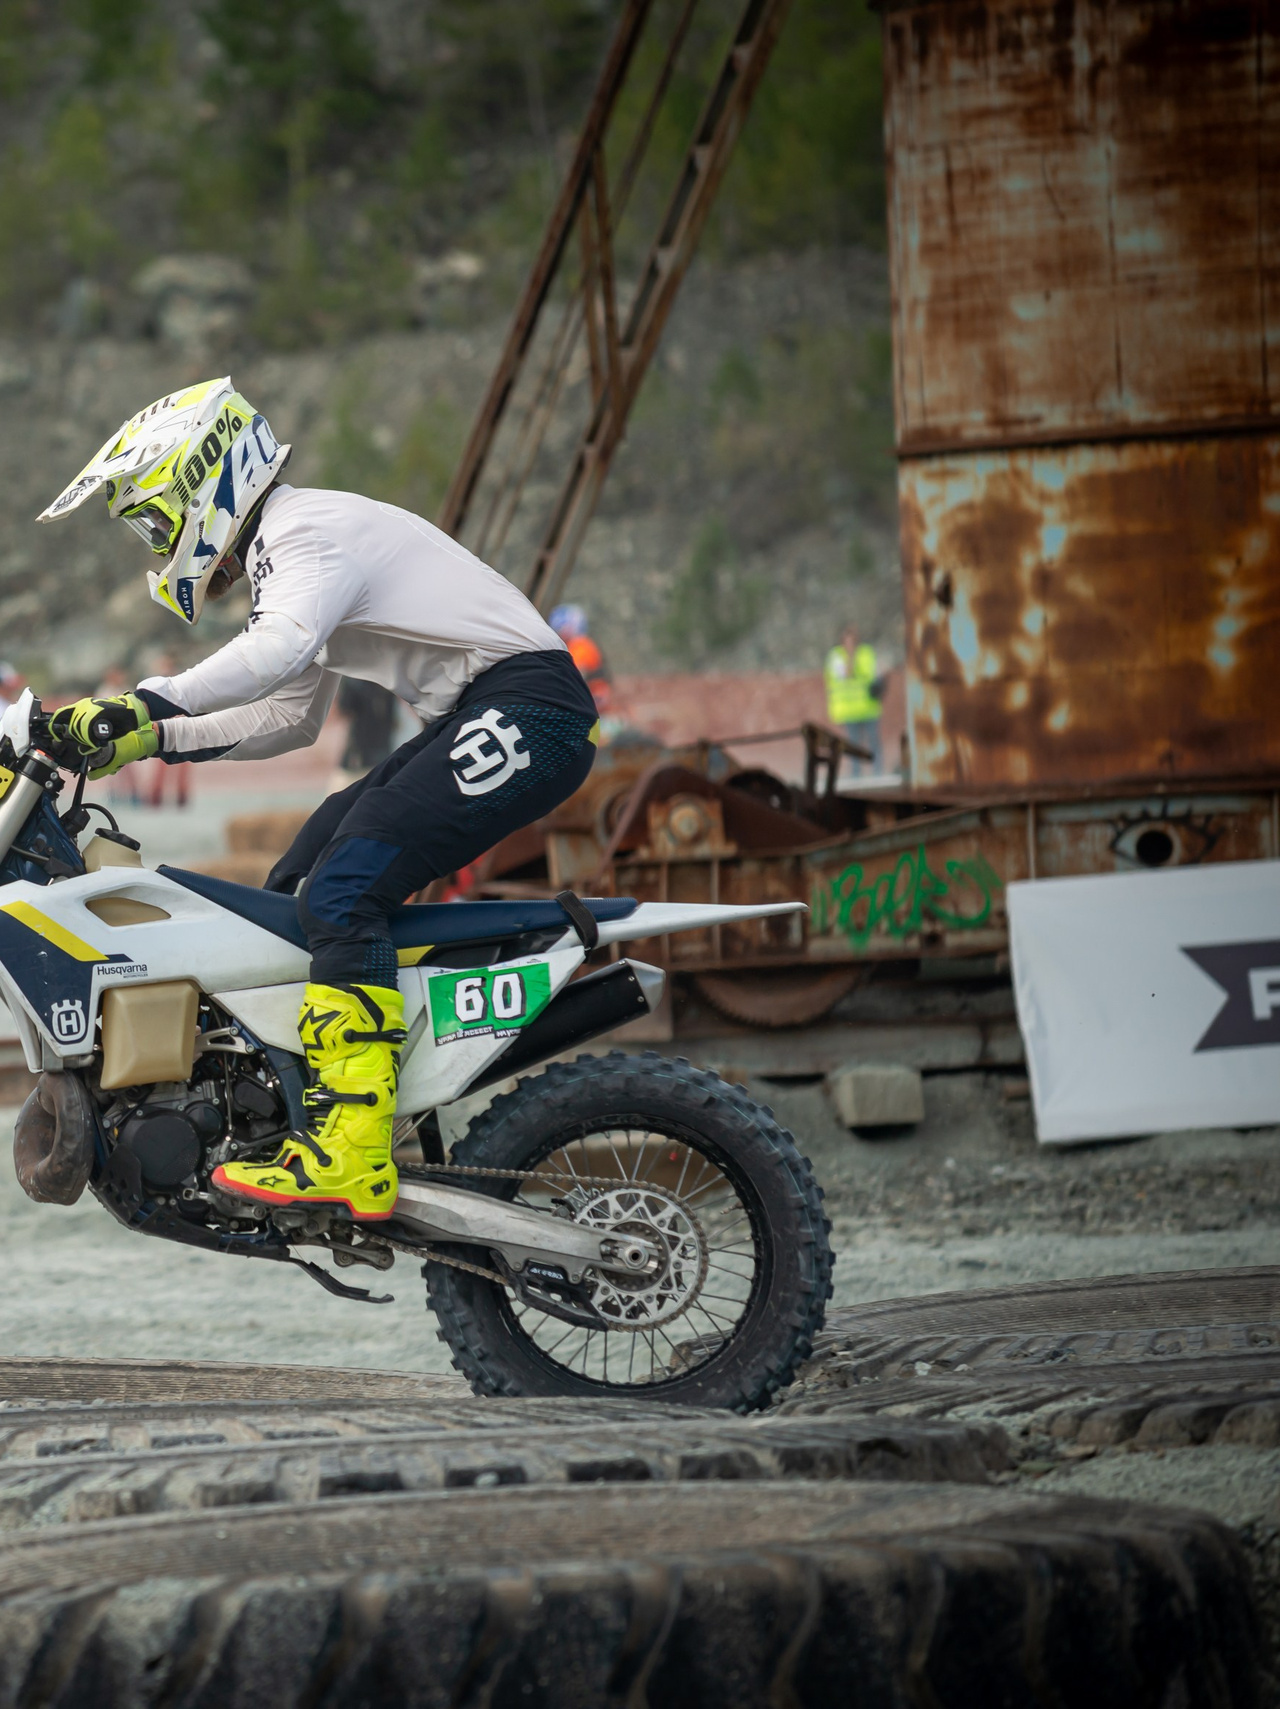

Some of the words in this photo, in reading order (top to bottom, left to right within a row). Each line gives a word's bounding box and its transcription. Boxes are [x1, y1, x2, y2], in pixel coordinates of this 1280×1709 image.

[170, 407, 243, 507] 100%
[180, 586, 193, 615] AIROH
[96, 963, 148, 976] Husqvarna
[454, 972, 524, 1023] 60
